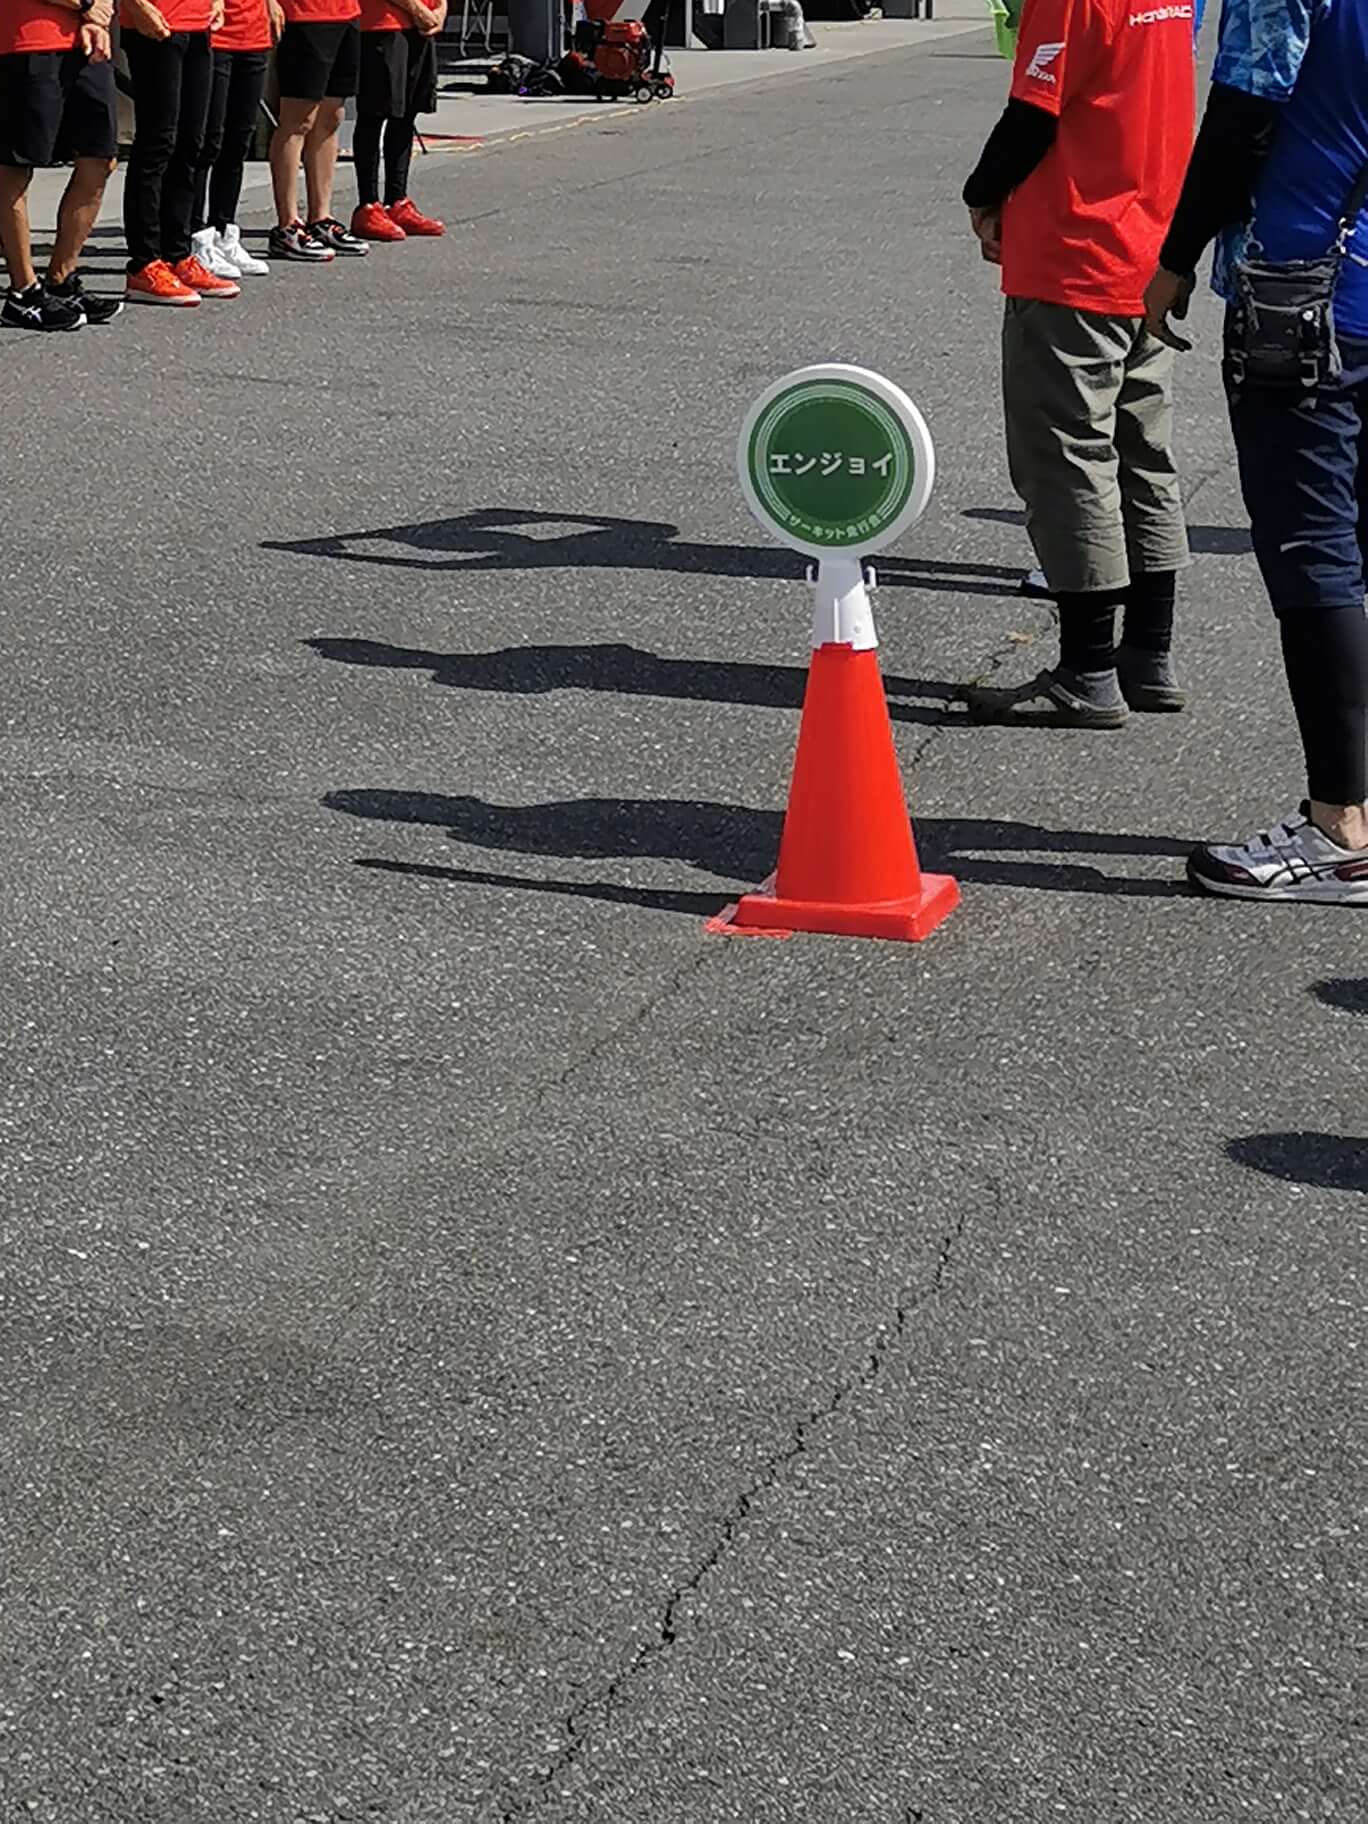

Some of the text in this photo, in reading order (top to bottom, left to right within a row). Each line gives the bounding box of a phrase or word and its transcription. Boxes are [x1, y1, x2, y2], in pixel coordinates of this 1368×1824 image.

[769, 451, 894, 477] エンジョイ
